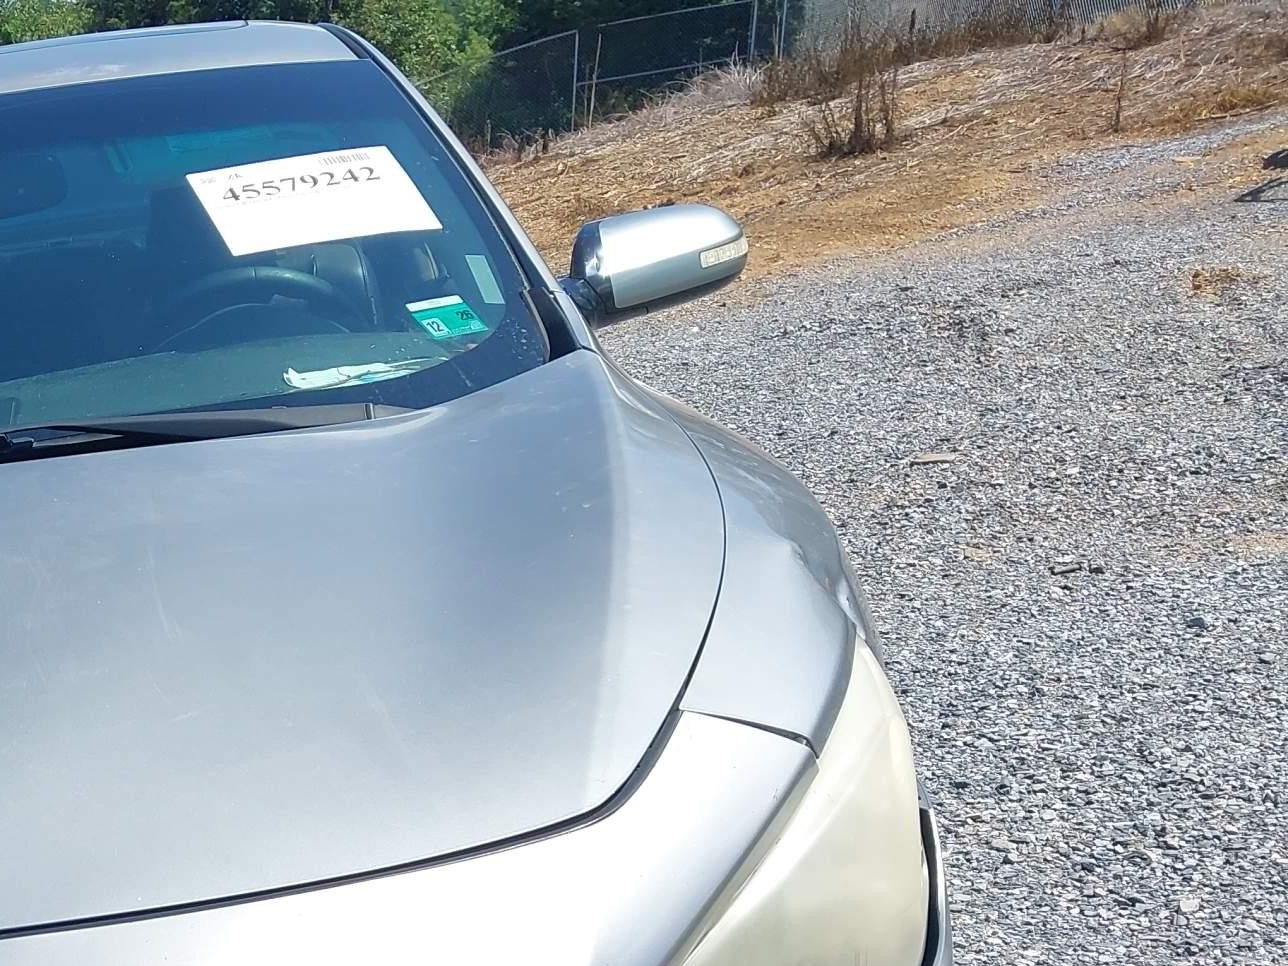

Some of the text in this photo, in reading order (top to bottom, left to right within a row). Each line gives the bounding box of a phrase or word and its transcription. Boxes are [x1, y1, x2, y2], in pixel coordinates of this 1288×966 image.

[222, 166, 381, 201] 45579242
[456, 310, 475, 320] 26
[426, 320, 445, 333] 12
